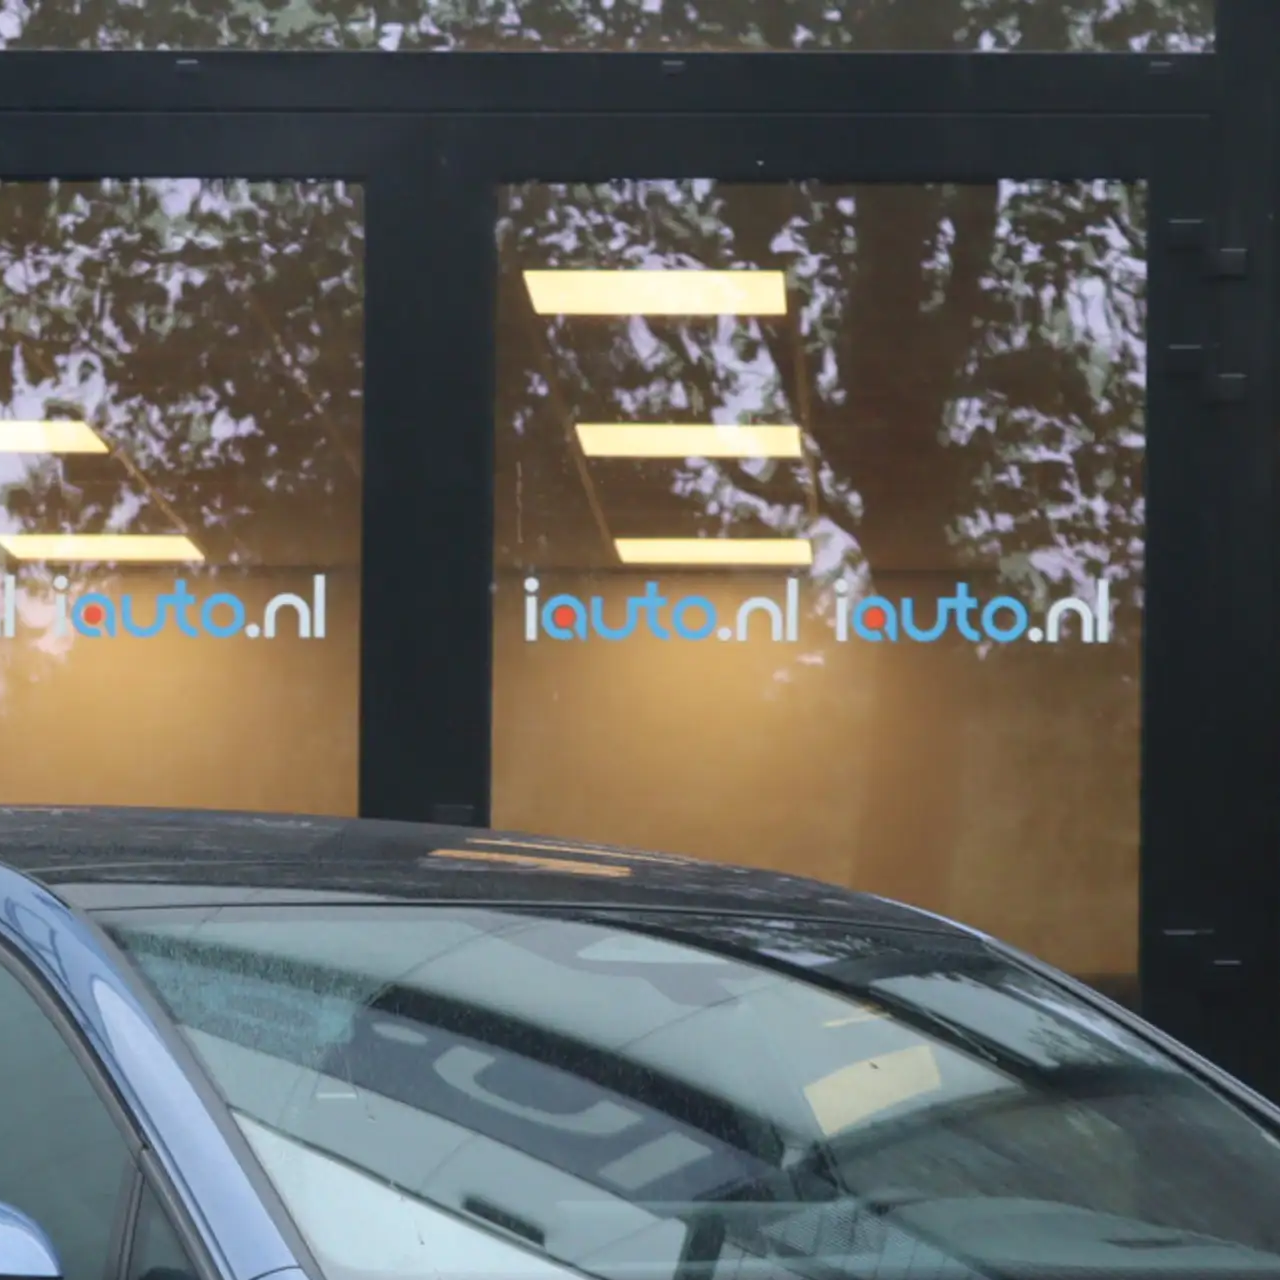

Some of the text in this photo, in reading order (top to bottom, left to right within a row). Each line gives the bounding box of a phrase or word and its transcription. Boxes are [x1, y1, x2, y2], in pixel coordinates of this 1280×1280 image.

[54, 574, 325, 638] iauto.nl
[524, 577, 797, 641] iauto.nl
[835, 577, 1109, 642] iauto.nl
